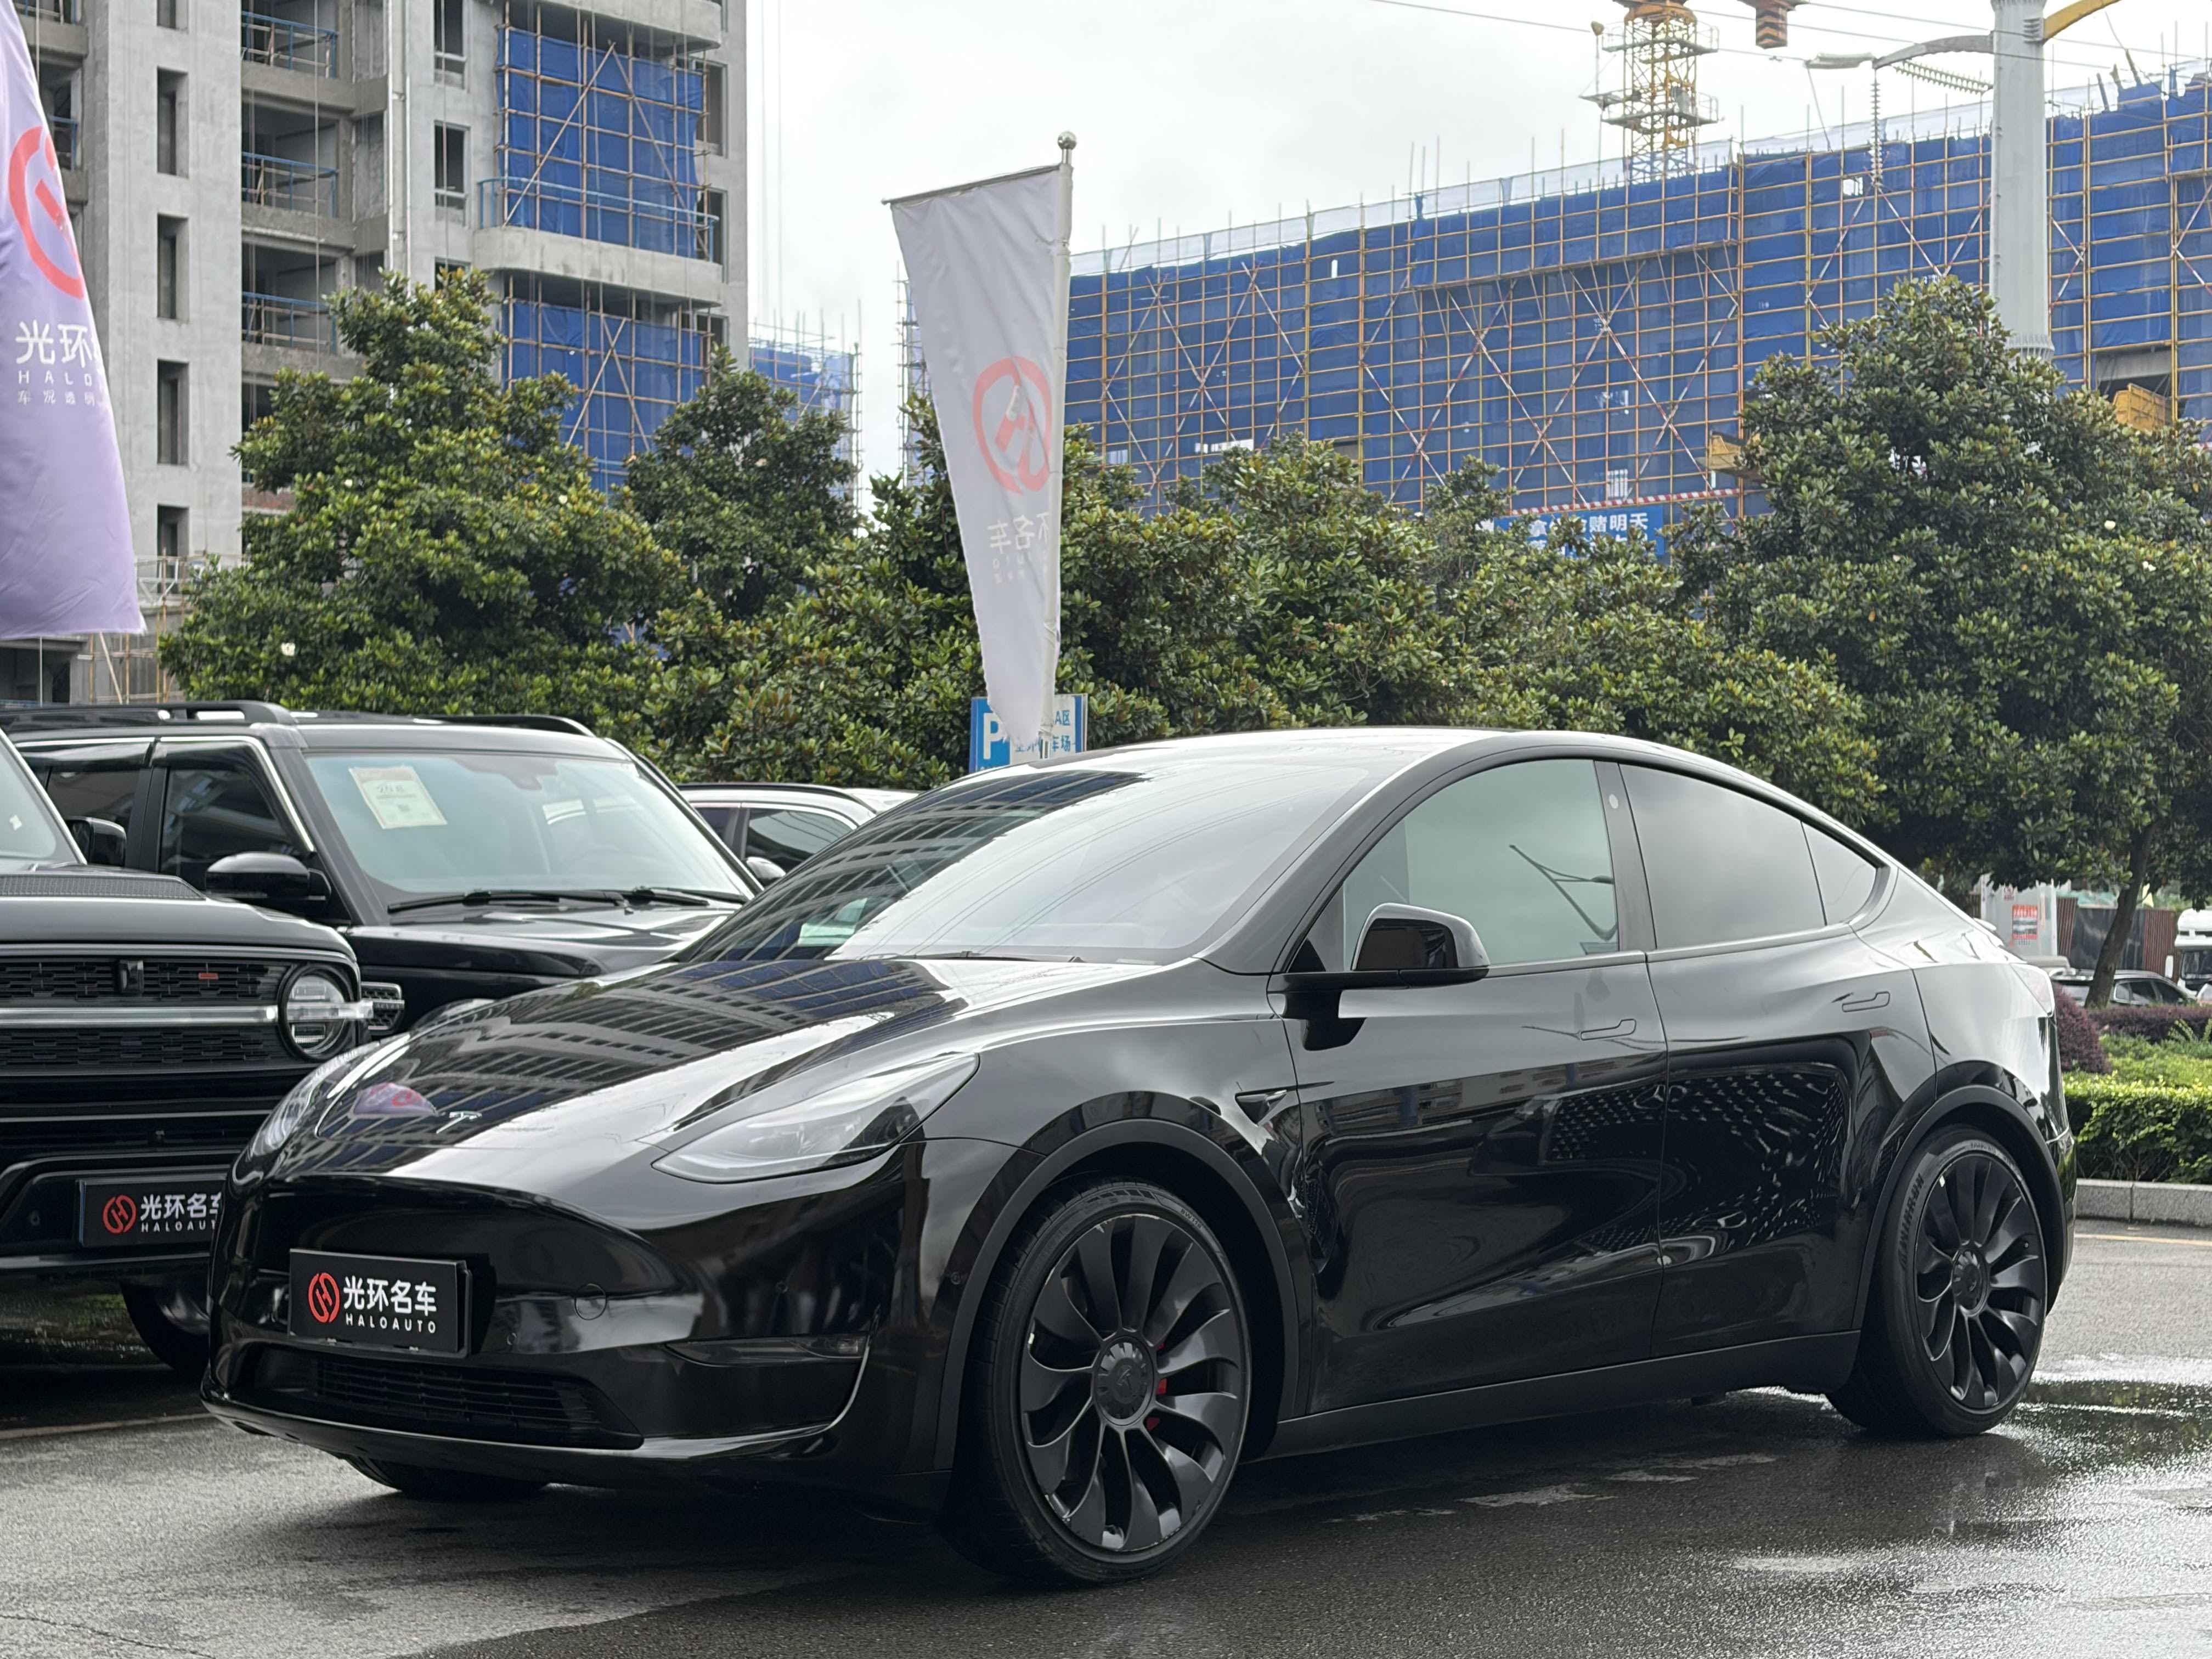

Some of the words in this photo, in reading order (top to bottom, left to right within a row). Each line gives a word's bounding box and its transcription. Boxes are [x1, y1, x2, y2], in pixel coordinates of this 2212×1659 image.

[15, 319, 93, 369] 光环
[18, 370, 92, 386] HALO
[983, 713, 1006, 760] P
[142, 1220, 216, 1233] HALOAUT
[343, 1275, 437, 1316] 光环名车
[346, 1312, 436, 1334] HALOAUTO
